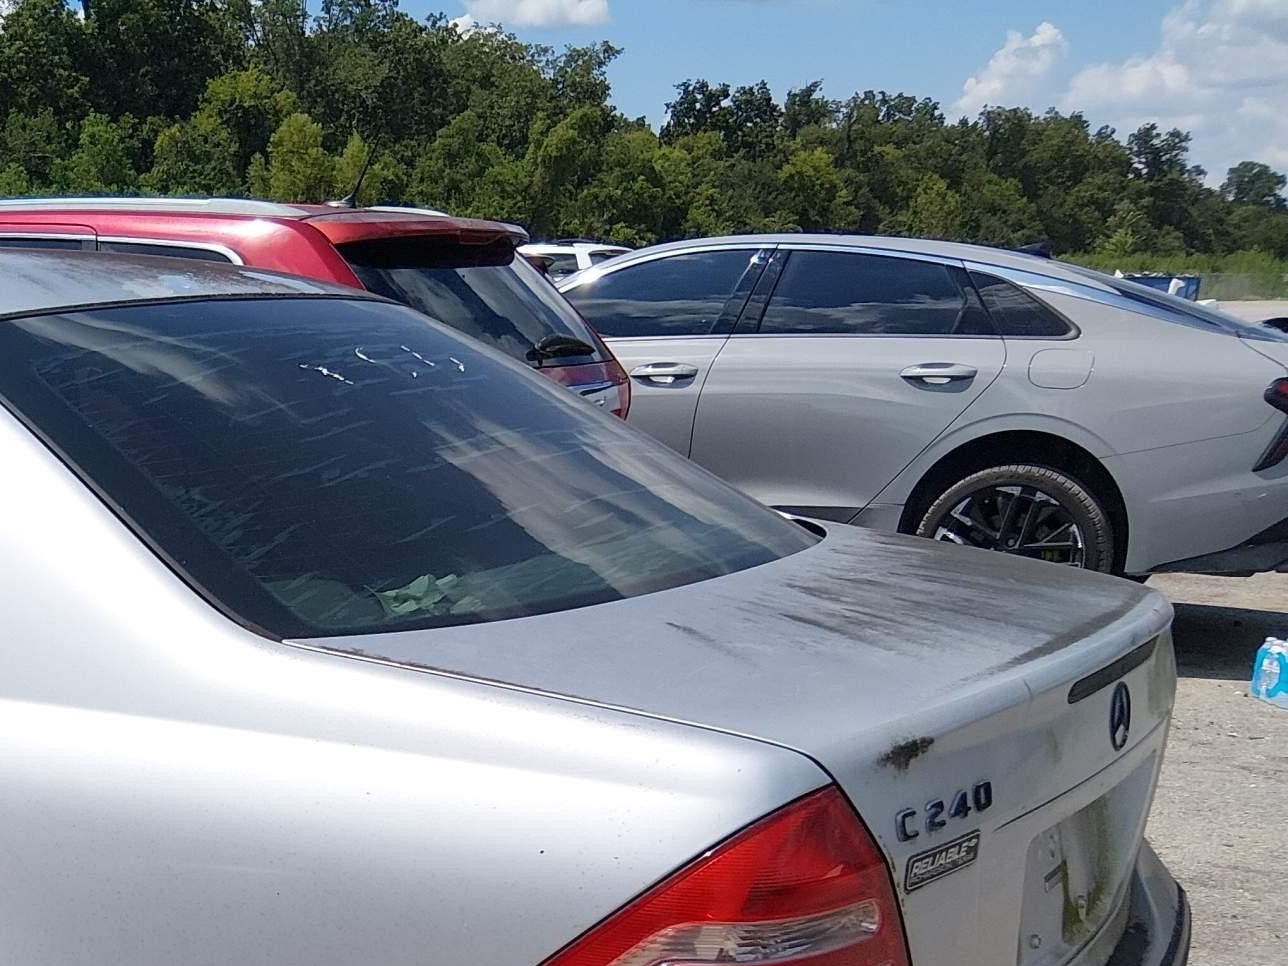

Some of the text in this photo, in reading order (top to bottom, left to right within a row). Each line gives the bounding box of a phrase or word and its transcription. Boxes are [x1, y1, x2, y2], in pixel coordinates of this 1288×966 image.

[895, 781, 993, 843] C 240
[911, 843, 970, 877] RELIABLE
